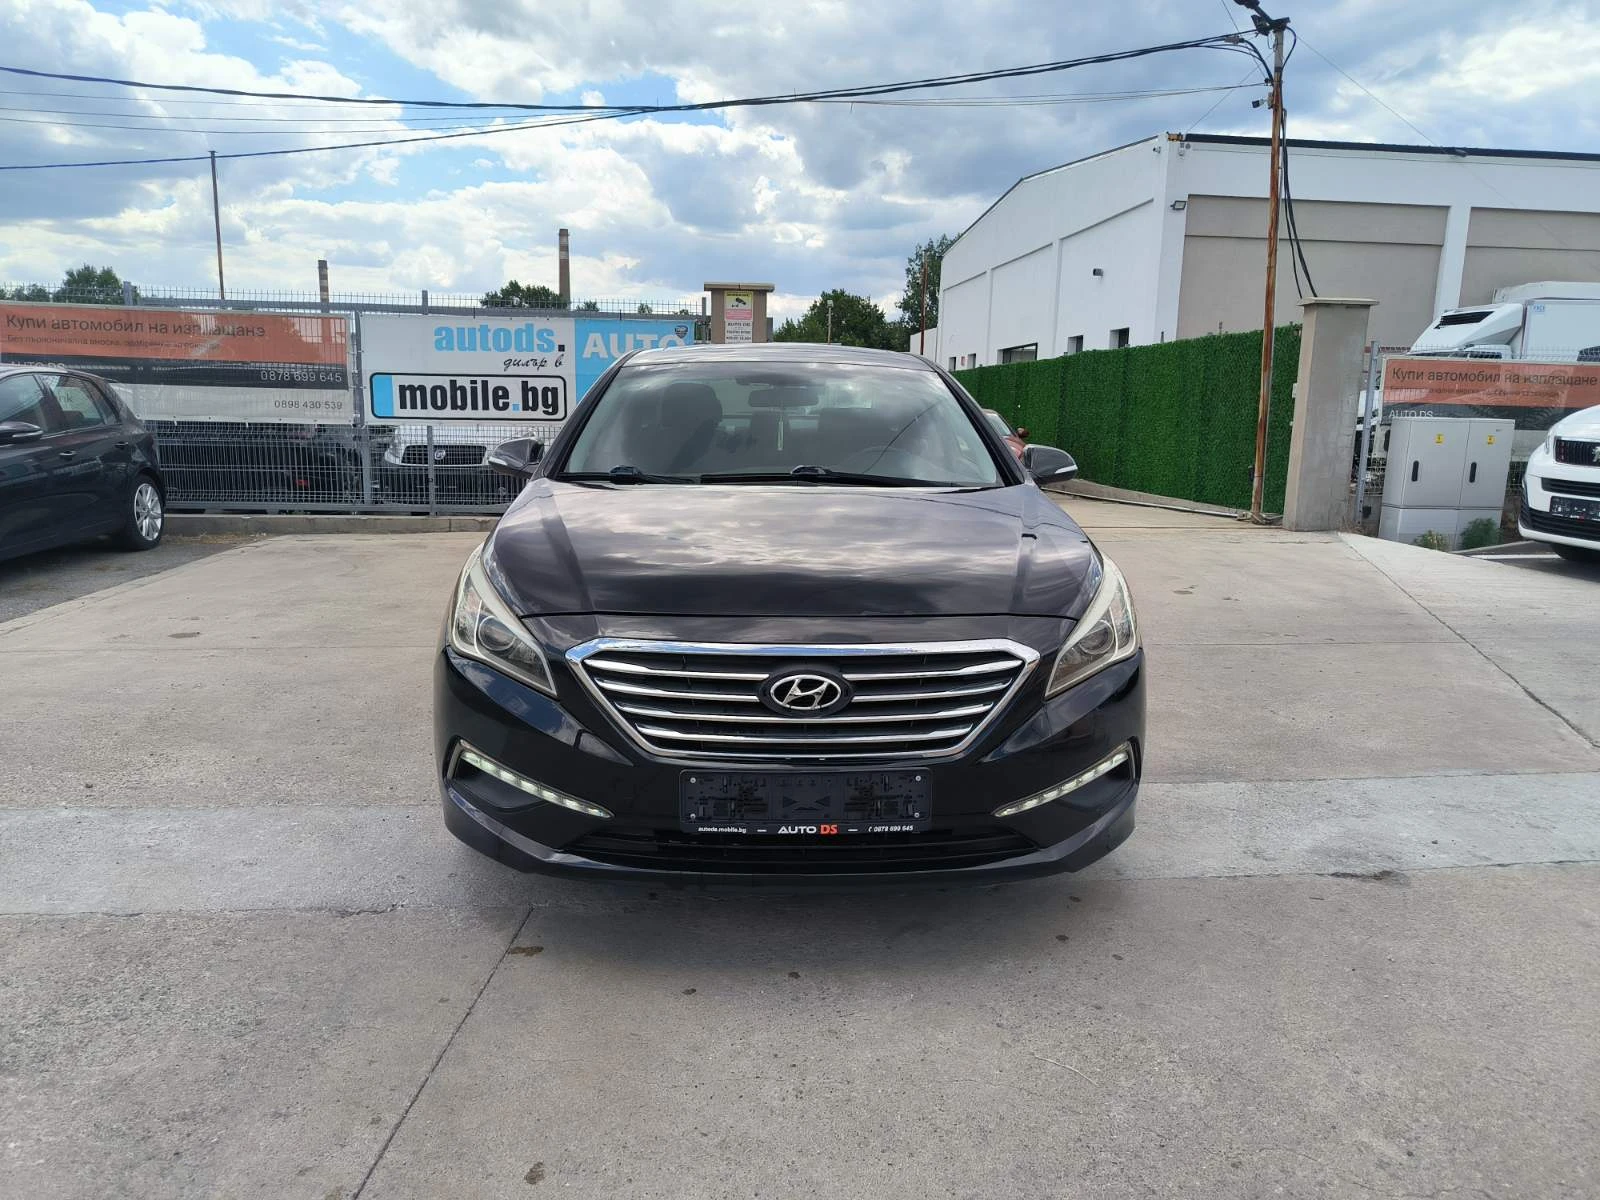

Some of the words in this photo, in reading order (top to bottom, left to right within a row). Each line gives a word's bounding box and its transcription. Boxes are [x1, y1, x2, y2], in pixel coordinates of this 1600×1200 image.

[6, 314, 46, 331] Купи
[51, 318, 144, 333] автомобил
[149, 322, 168, 334] на
[260, 370, 290, 381] 0878
[293, 371, 316, 382] 699
[319, 372, 342, 383] 645
[1392, 367, 1424, 382] Купи
[1427, 370, 1500, 383] автомобил
[1504, 373, 1520, 384] на
[274, 400, 300, 409] 0898
[302, 400, 321, 409] 430
[398, 379, 560, 416] mobile.bg
[778, 825, 818, 834] AUTO
[820, 824, 839, 835] DS
